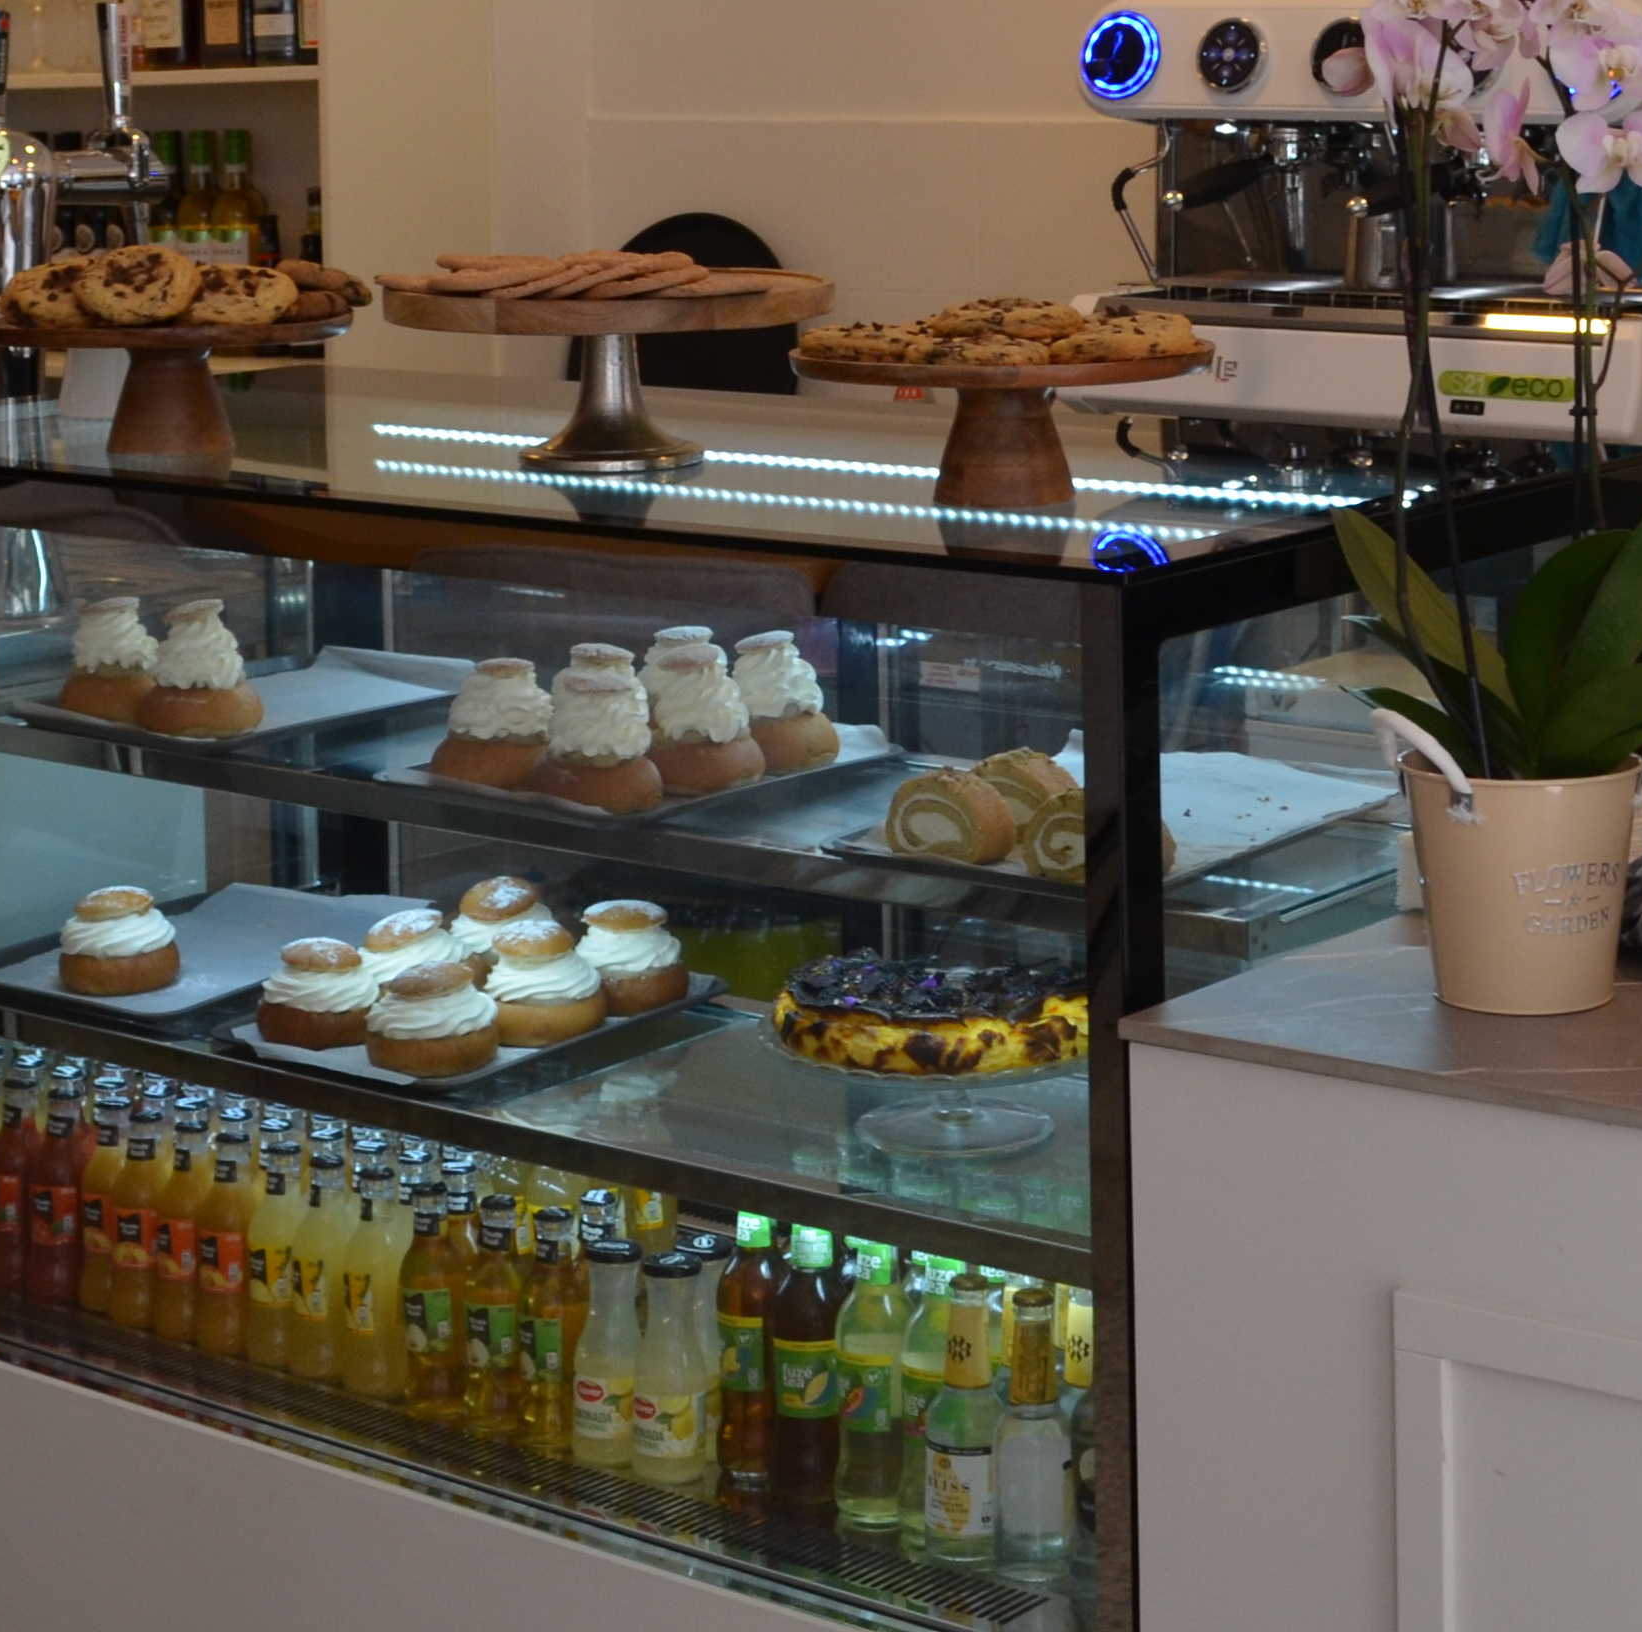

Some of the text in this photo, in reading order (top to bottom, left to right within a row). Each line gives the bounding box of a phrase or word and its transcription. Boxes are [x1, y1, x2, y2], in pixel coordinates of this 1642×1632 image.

[1451, 372, 1564, 399] S21 eco
[1513, 862, 1621, 897] FLOWERS
[1525, 906, 1611, 936] GARDEN
[782, 1362, 813, 1379] fuze
[784, 1375, 805, 1388] tea
